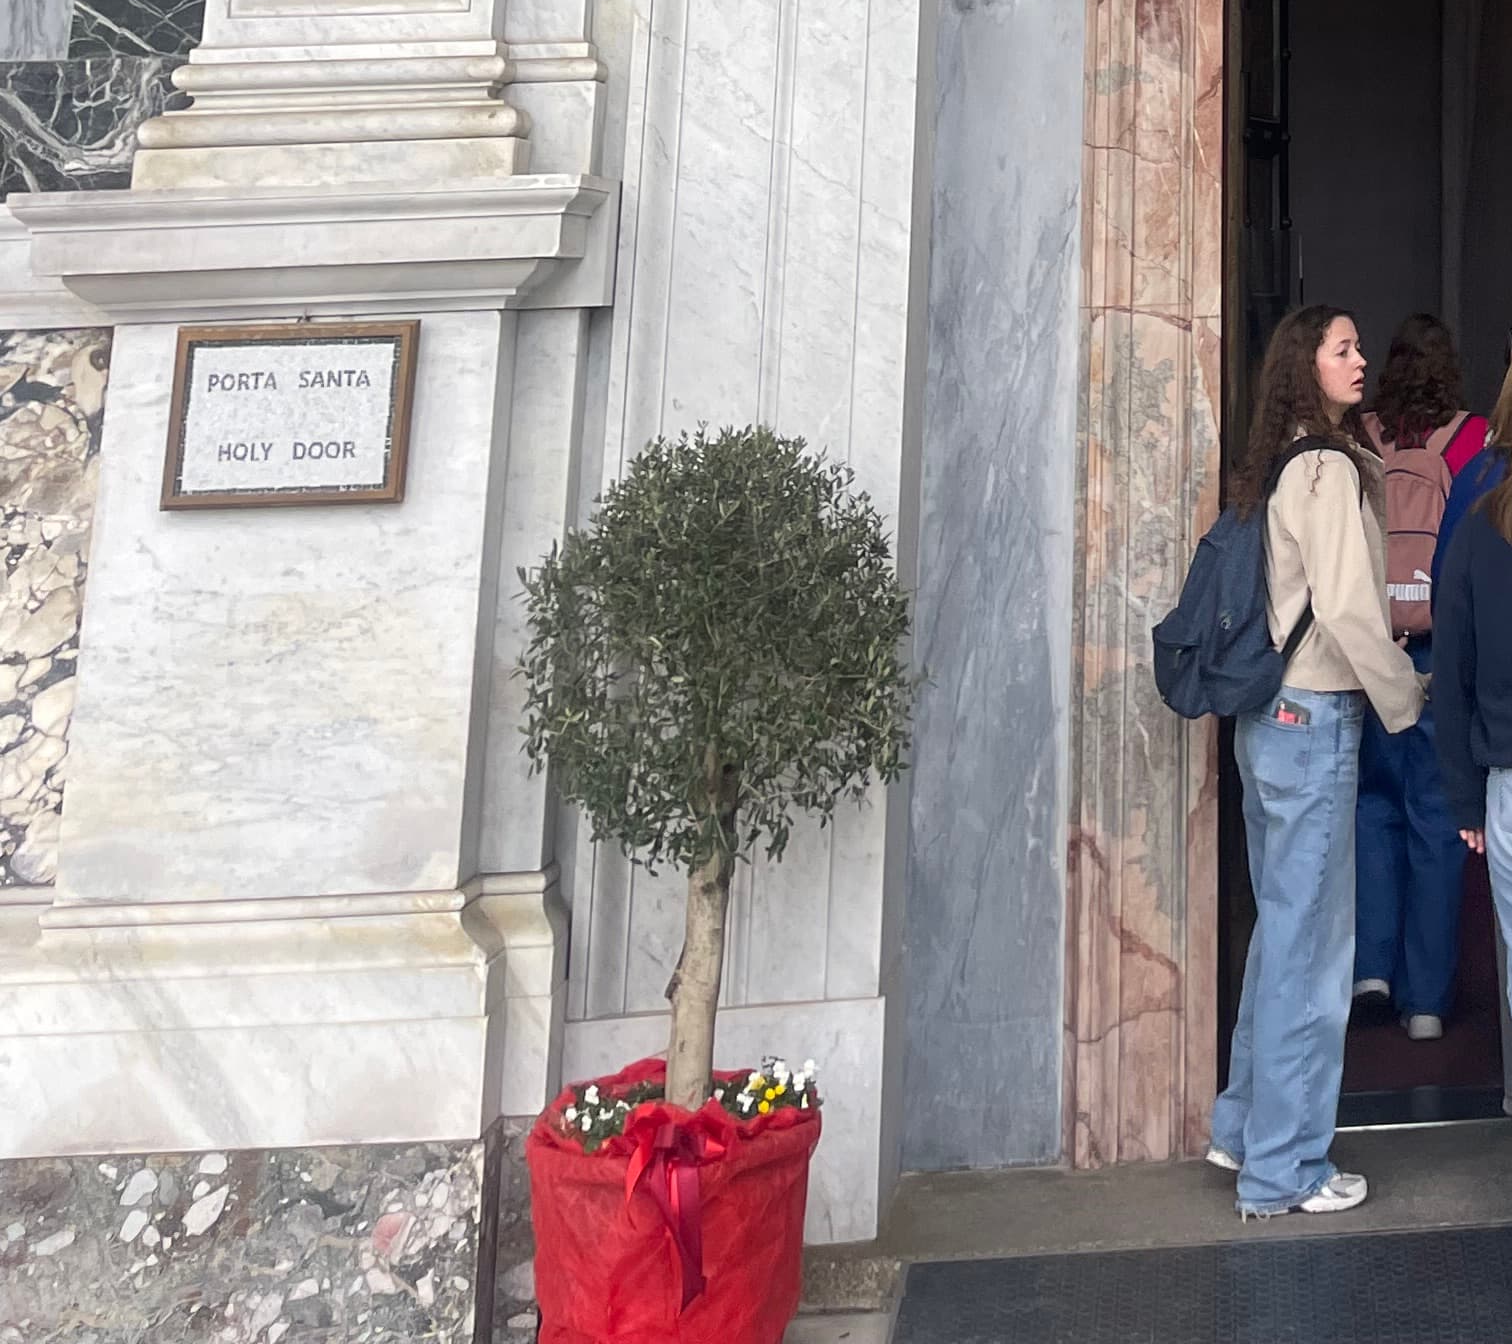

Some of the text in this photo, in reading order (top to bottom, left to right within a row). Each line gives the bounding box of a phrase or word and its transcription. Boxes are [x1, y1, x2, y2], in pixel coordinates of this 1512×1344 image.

[207, 369, 372, 393] PORTA SANTA
[217, 440, 357, 462] HOLY DOOR
